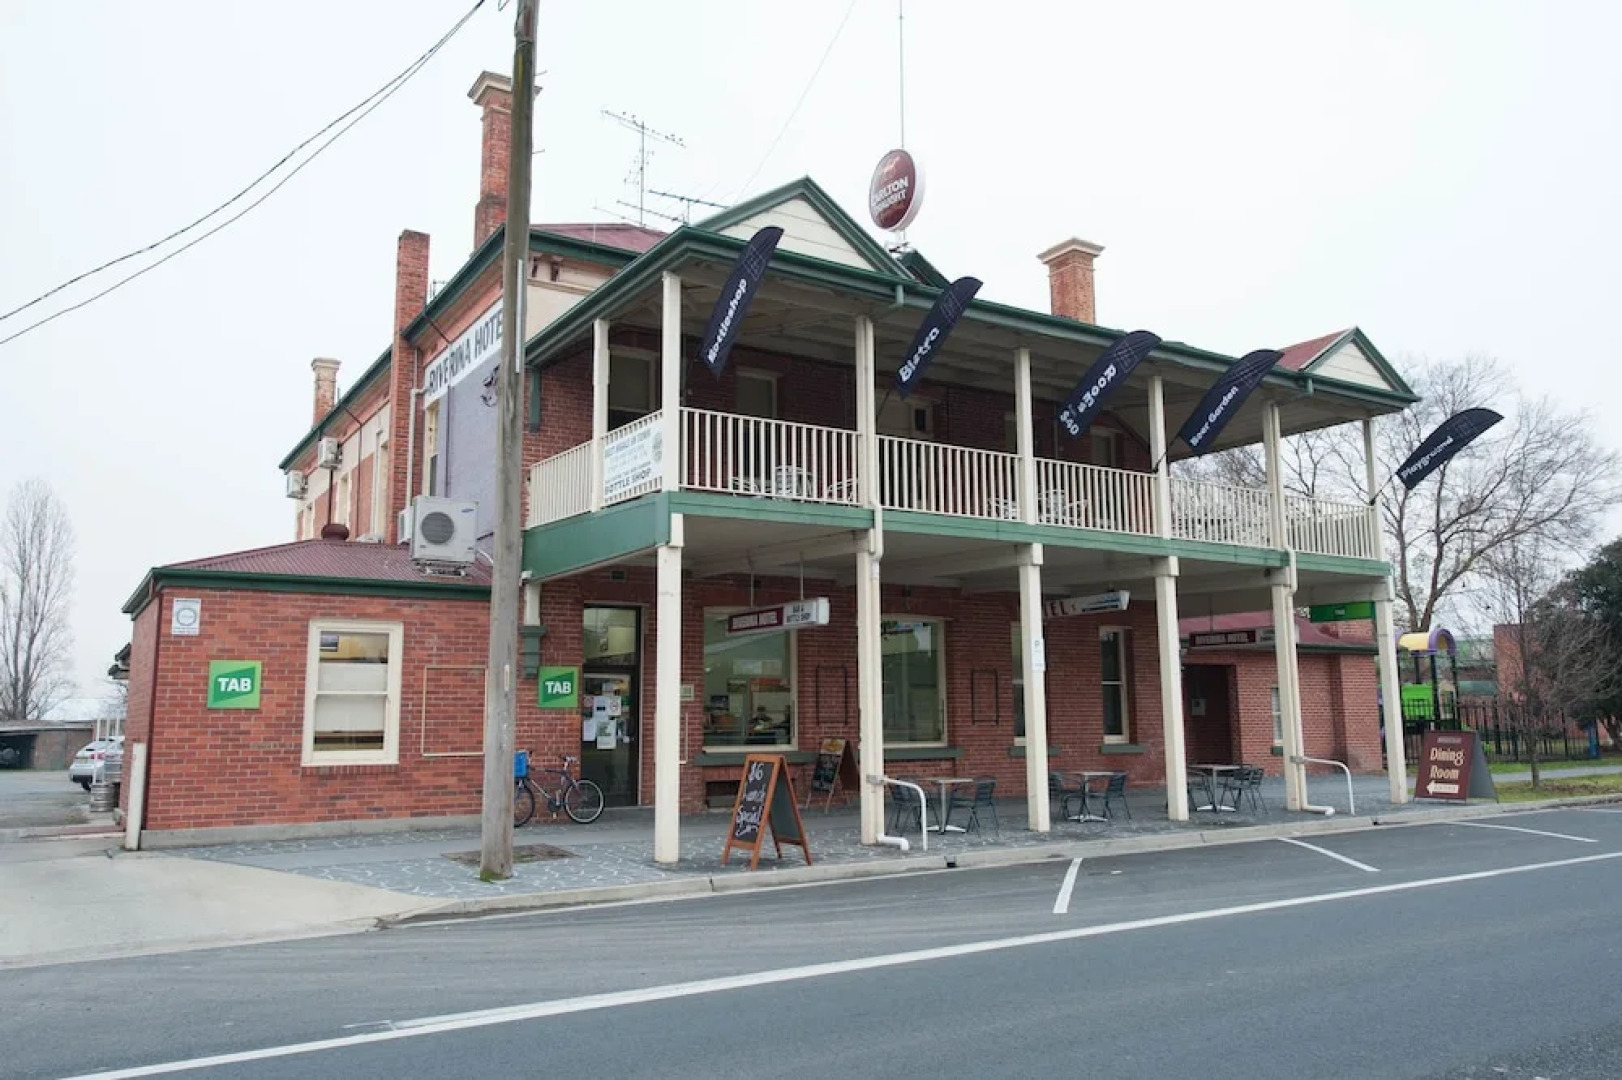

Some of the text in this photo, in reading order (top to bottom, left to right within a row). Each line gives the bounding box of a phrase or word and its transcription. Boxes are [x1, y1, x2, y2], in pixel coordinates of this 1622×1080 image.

[429, 338, 471, 397] RIVERINA
[898, 327, 940, 383] Bistro
[1189, 385, 1239, 447] Beer Garden
[1400, 435, 1454, 480] Playground
[217, 677, 251, 692] TAB
[545, 680, 572, 695] TAB
[1430, 747, 1465, 766] Dining
[1430, 765, 1460, 780] Room
